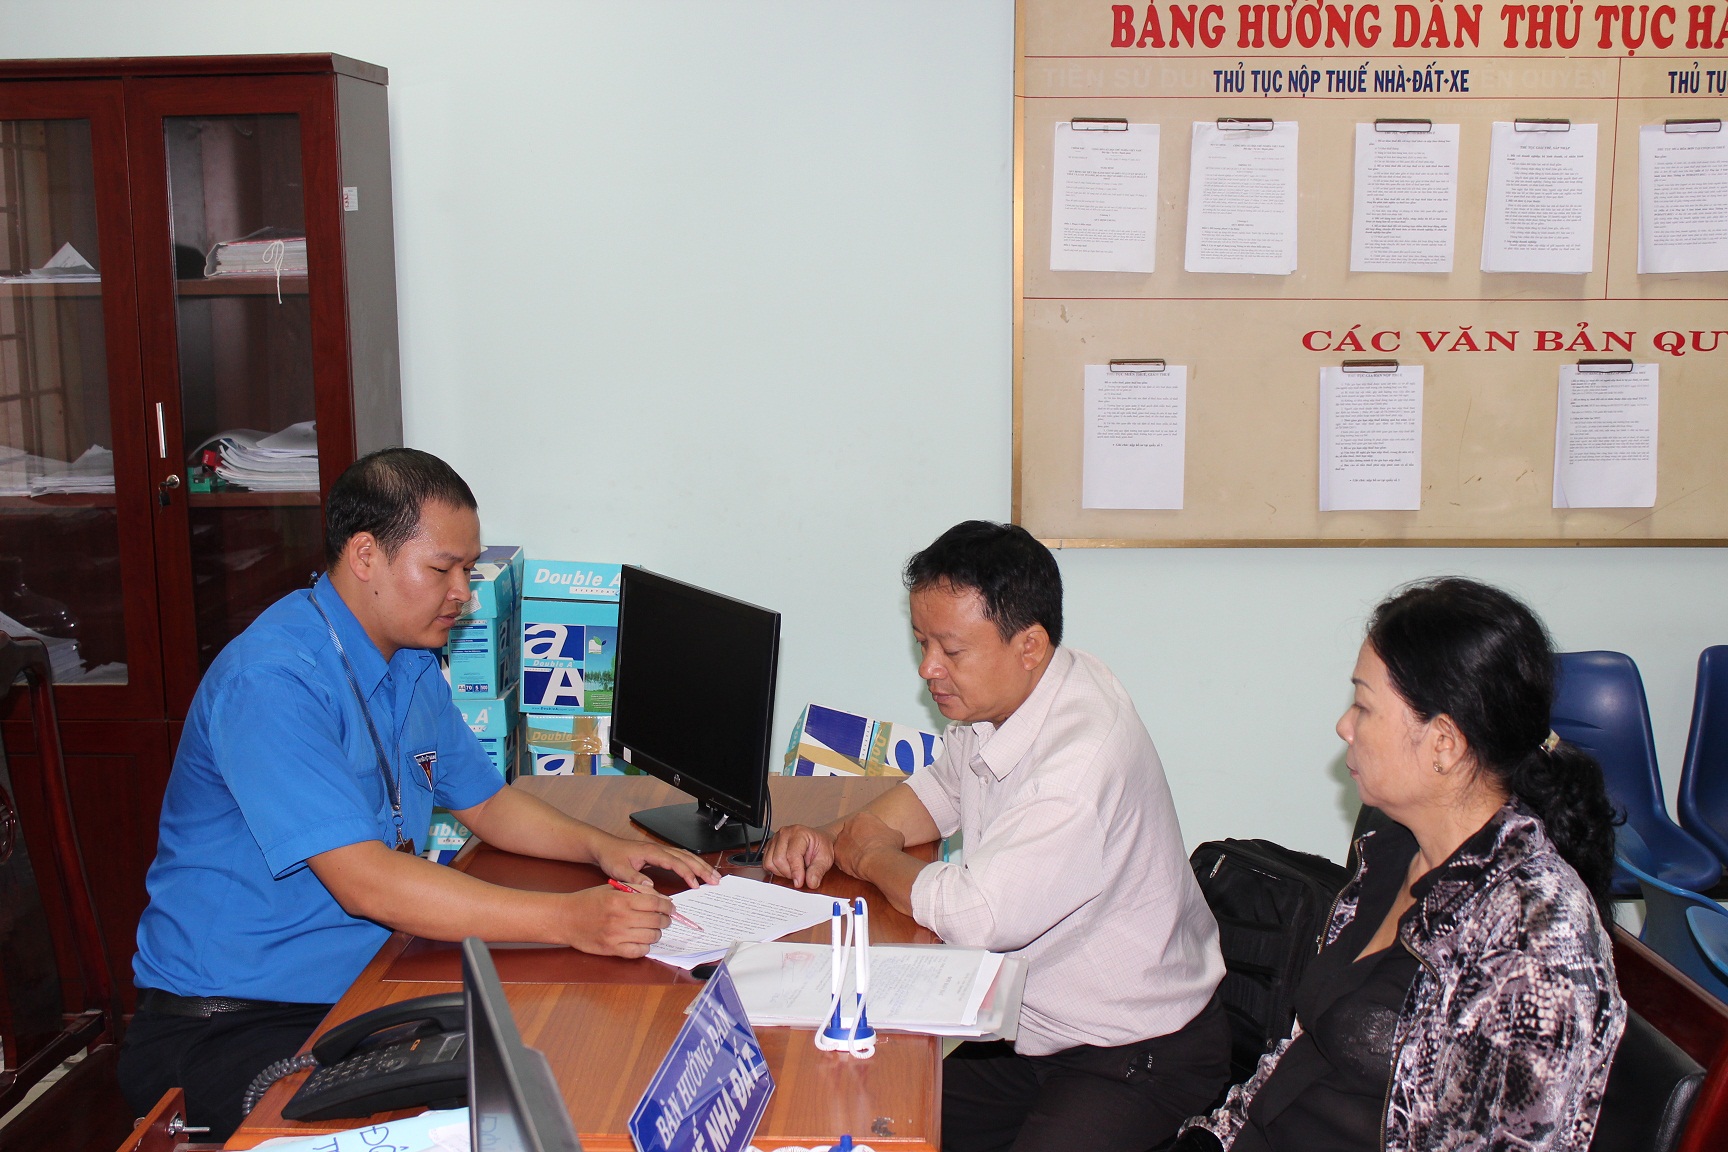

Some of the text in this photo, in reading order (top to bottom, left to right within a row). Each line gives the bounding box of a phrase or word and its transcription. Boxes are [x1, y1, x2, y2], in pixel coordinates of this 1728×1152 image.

[1595, 5, 1676, 57] TỤC
[1213, 62, 1245, 93] THỦ
[1251, 71, 1283, 98] TỤC
[1288, 65, 1321, 98] NỘP
[1326, 62, 1369, 93] THUẾ
[1668, 62, 1728, 96] THỦ TỤ
[1302, 321, 1728, 357] CÁC VĂN BẢN QU
[534, 568, 603, 587] Double
[533, 659, 564, 668] Double
[532, 731, 573, 741] Double
[705, 1077, 741, 1152] NHÀ
[729, 1035, 760, 1111] ĐẤT
